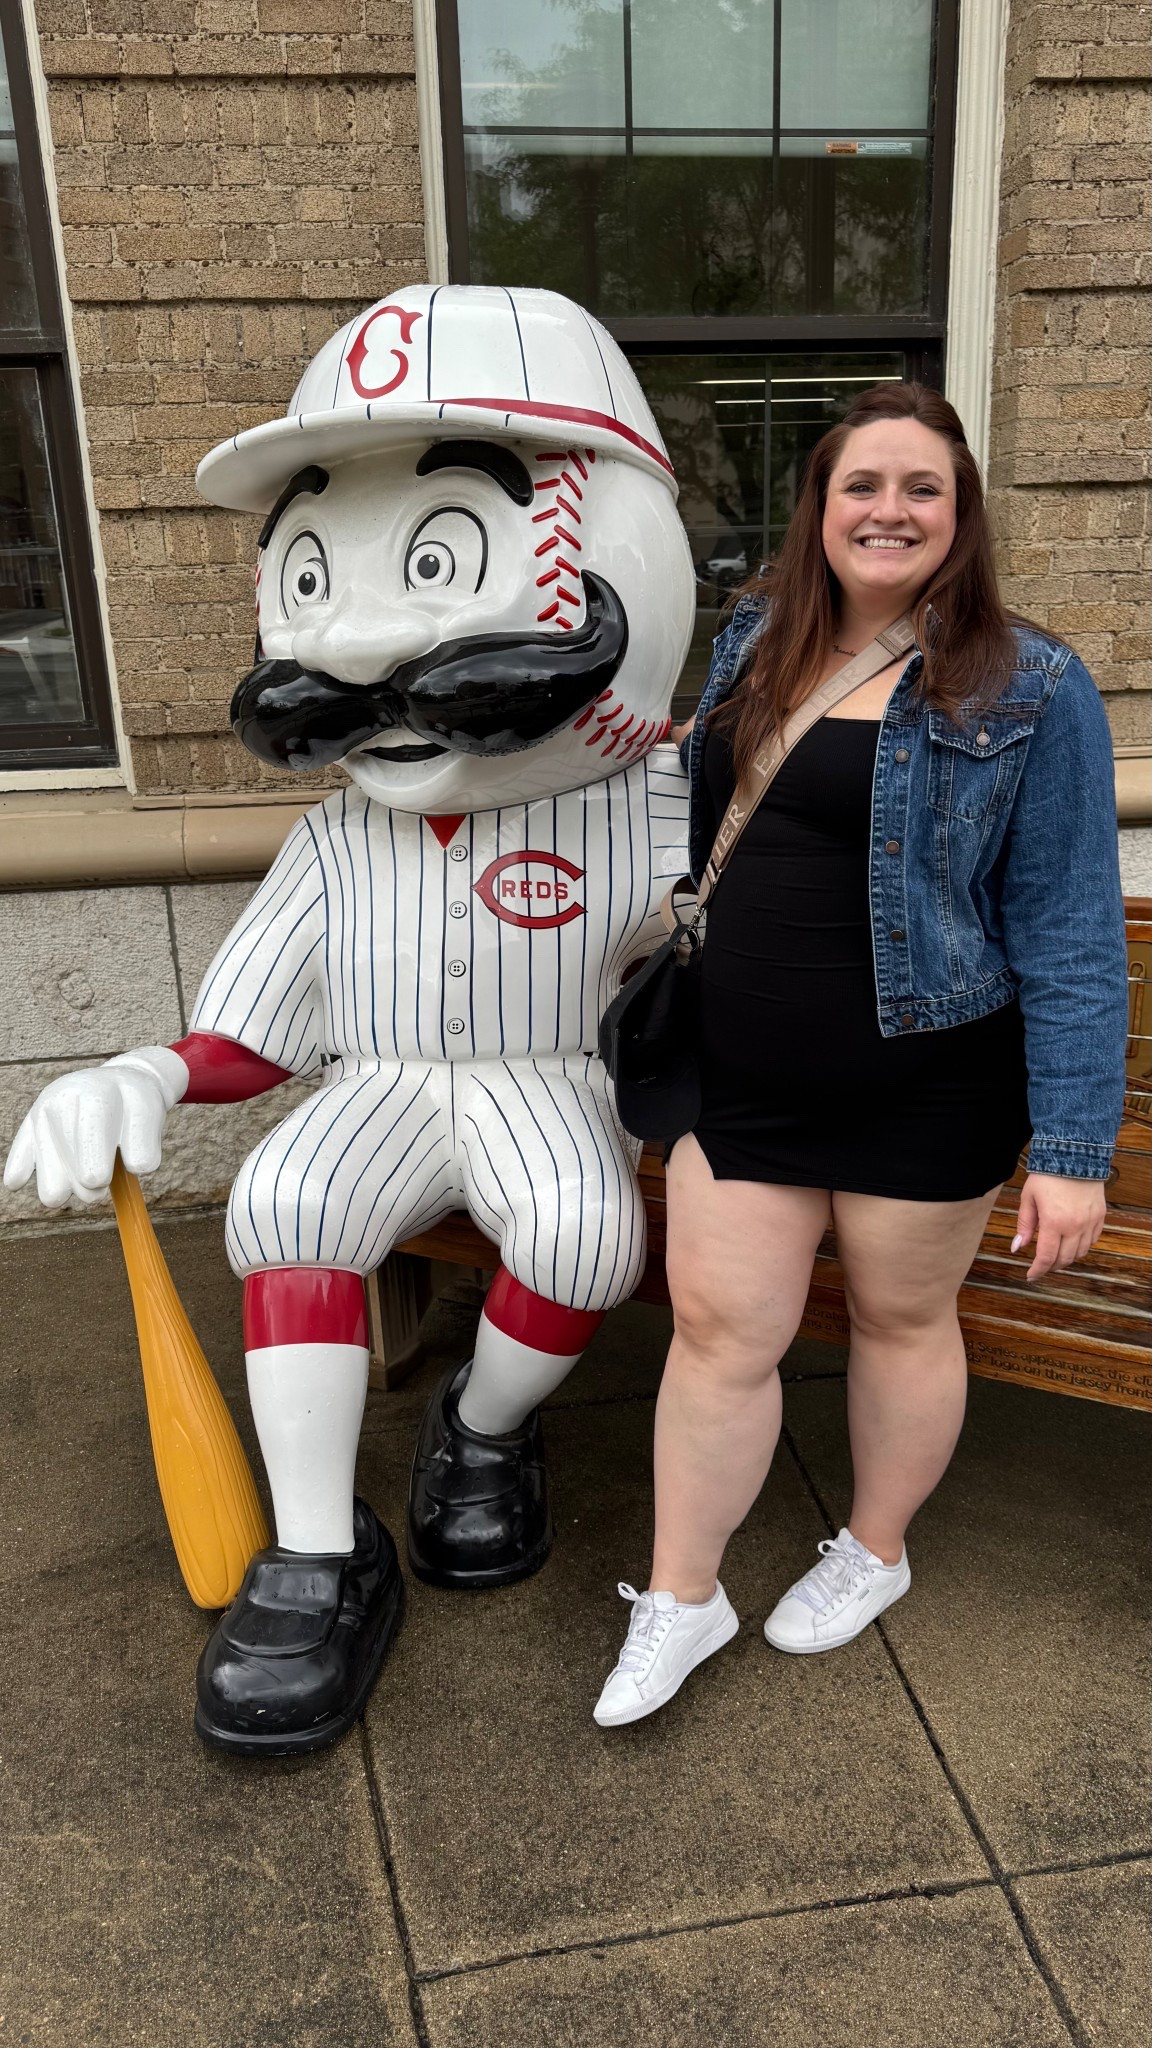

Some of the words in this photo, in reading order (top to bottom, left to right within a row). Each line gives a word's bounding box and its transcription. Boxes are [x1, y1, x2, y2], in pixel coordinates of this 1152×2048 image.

[346, 305, 423, 399] C
[713, 803, 746, 860] IER
[471, 850, 588, 929] C
[501, 879, 569, 900] REDS
[978, 1341, 1017, 1359] Series
[1020, 1352, 1104, 1378] appearance,
[1108, 1369, 1131, 1383] the
[1133, 1375, 1152, 1387] clu
[990, 1357, 1020, 1372] logo
[1023, 1366, 1042, 1377] on
[1044, 1367, 1067, 1383] the
[1069, 1372, 1112, 1393] jersey
